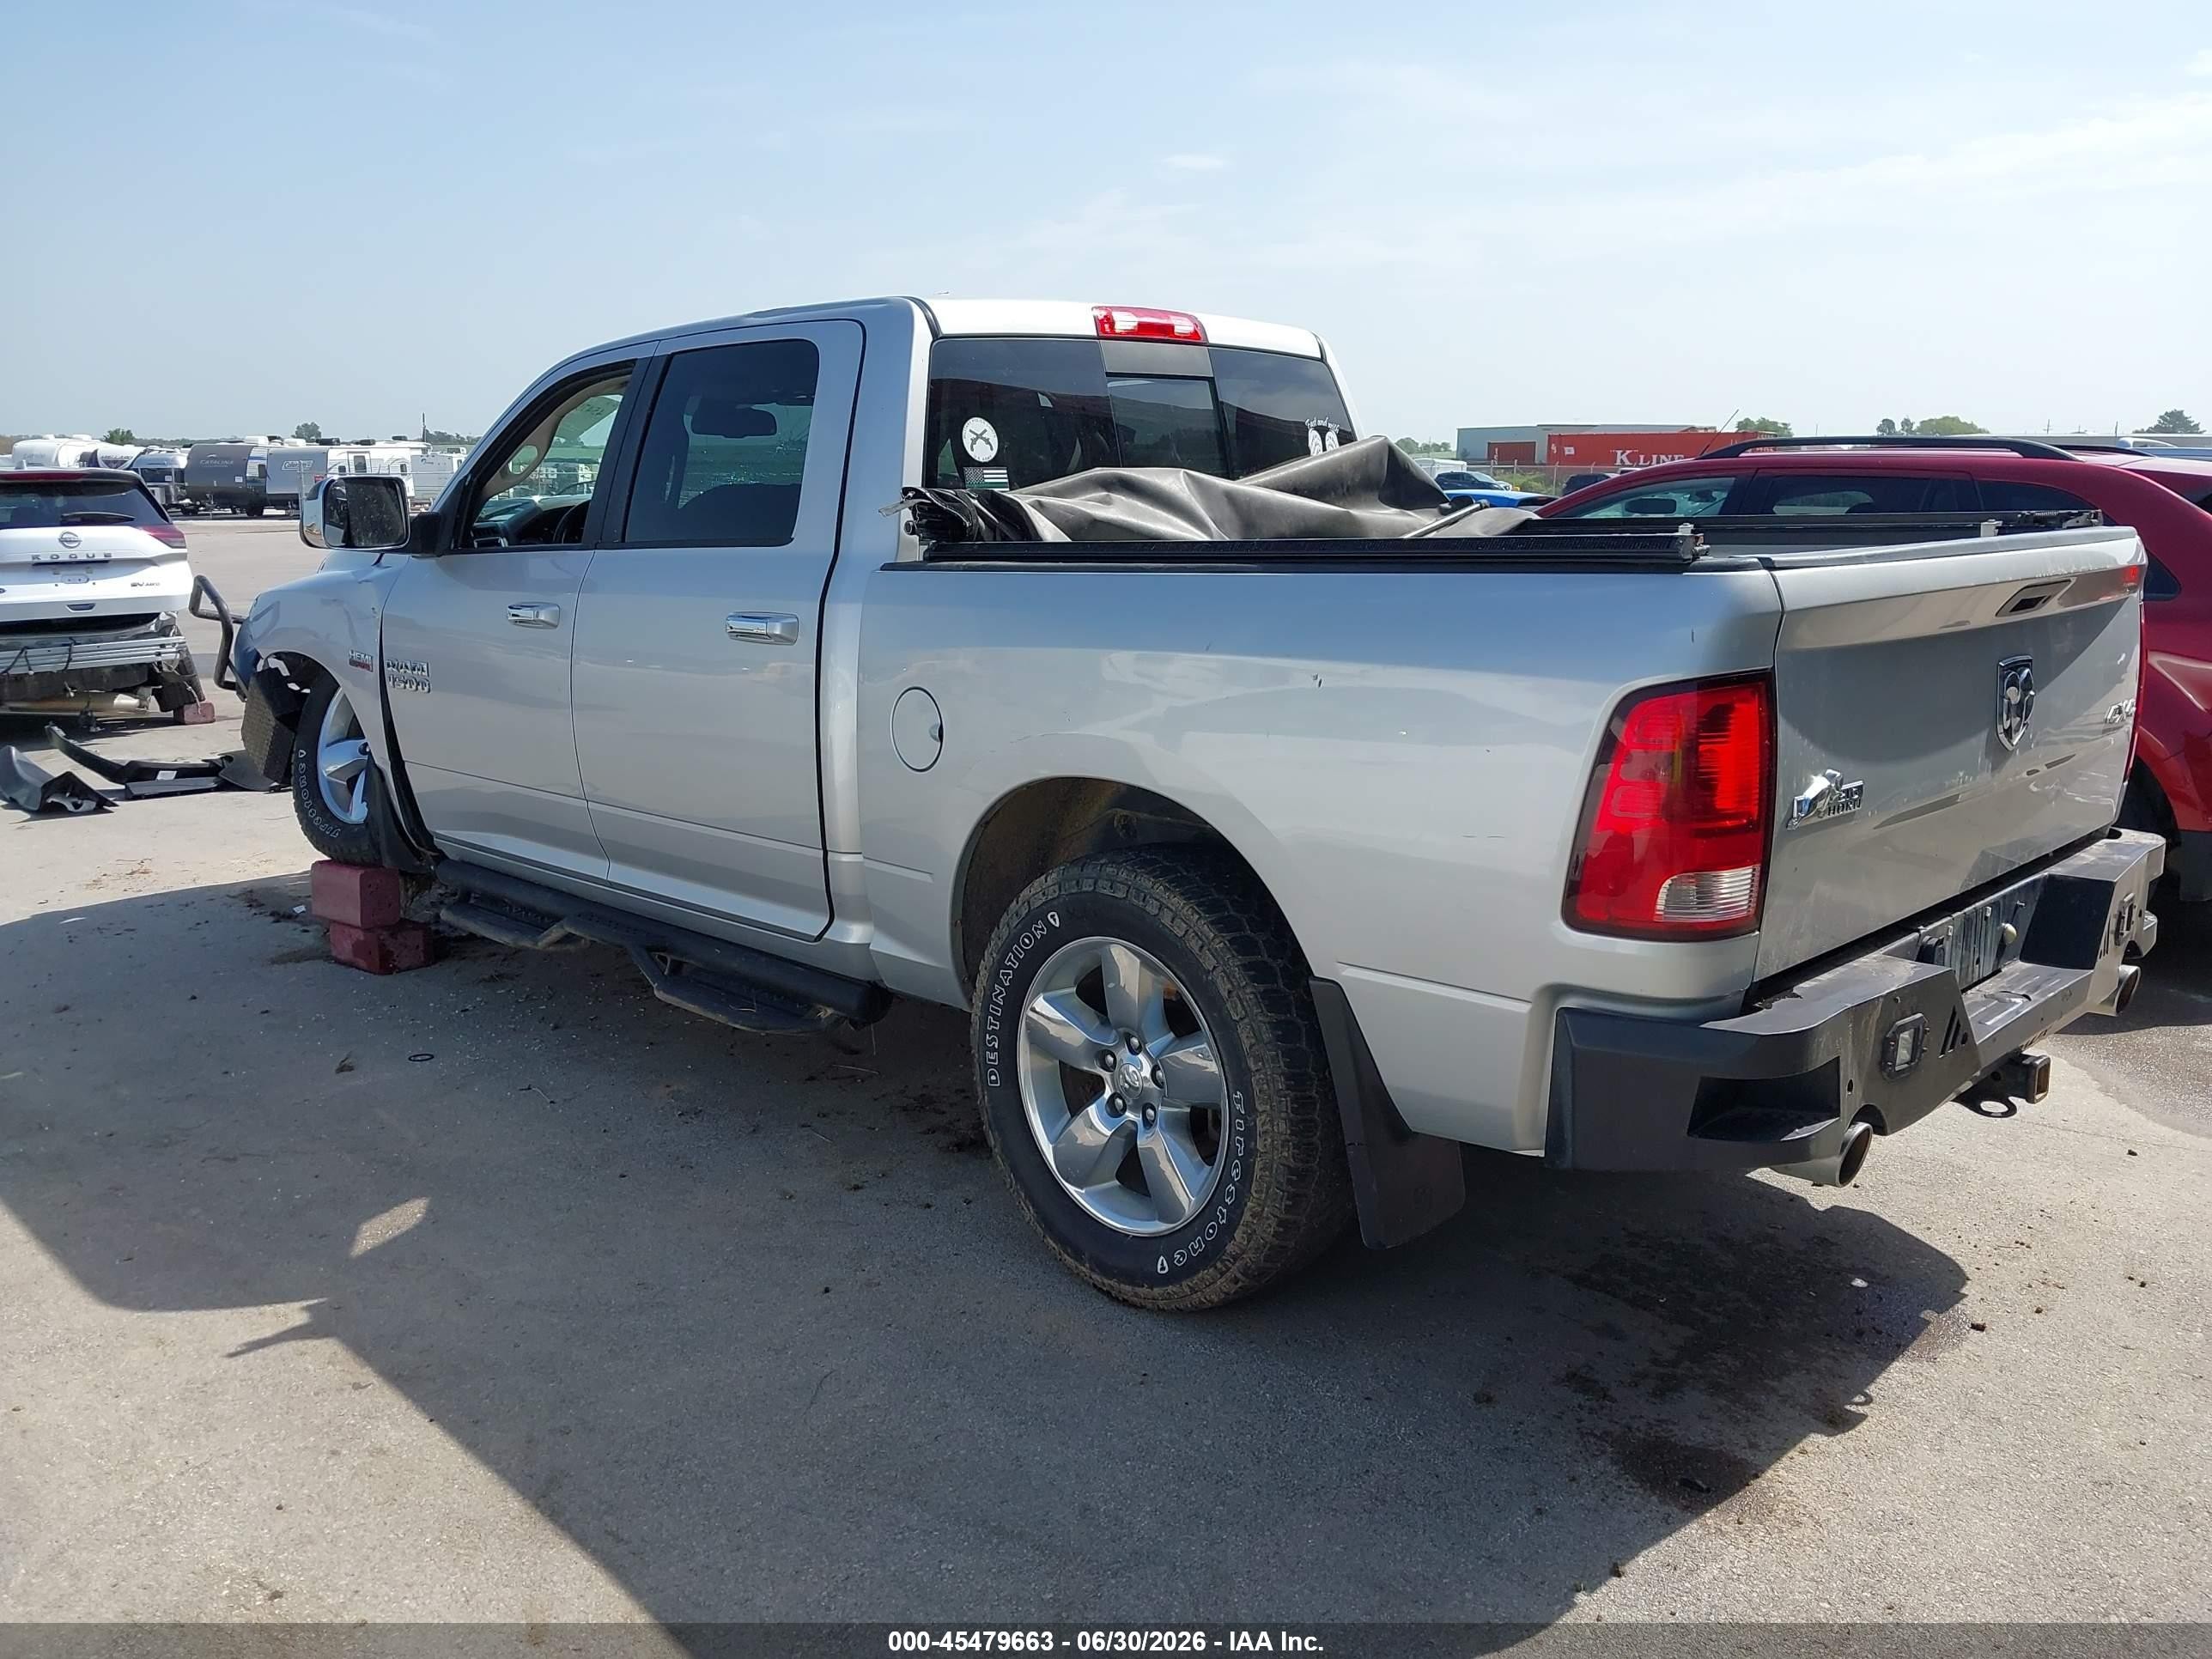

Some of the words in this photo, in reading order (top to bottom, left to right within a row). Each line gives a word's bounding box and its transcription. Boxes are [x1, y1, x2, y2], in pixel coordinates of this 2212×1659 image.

[31, 552, 112, 561] ROGUE
[349, 648, 374, 665] HEMI
[386, 658, 430, 678] RAM
[389, 674, 431, 694] 1500
[1827, 798, 1862, 817] HORN
[986, 920, 1048, 1087] DESTINATION
